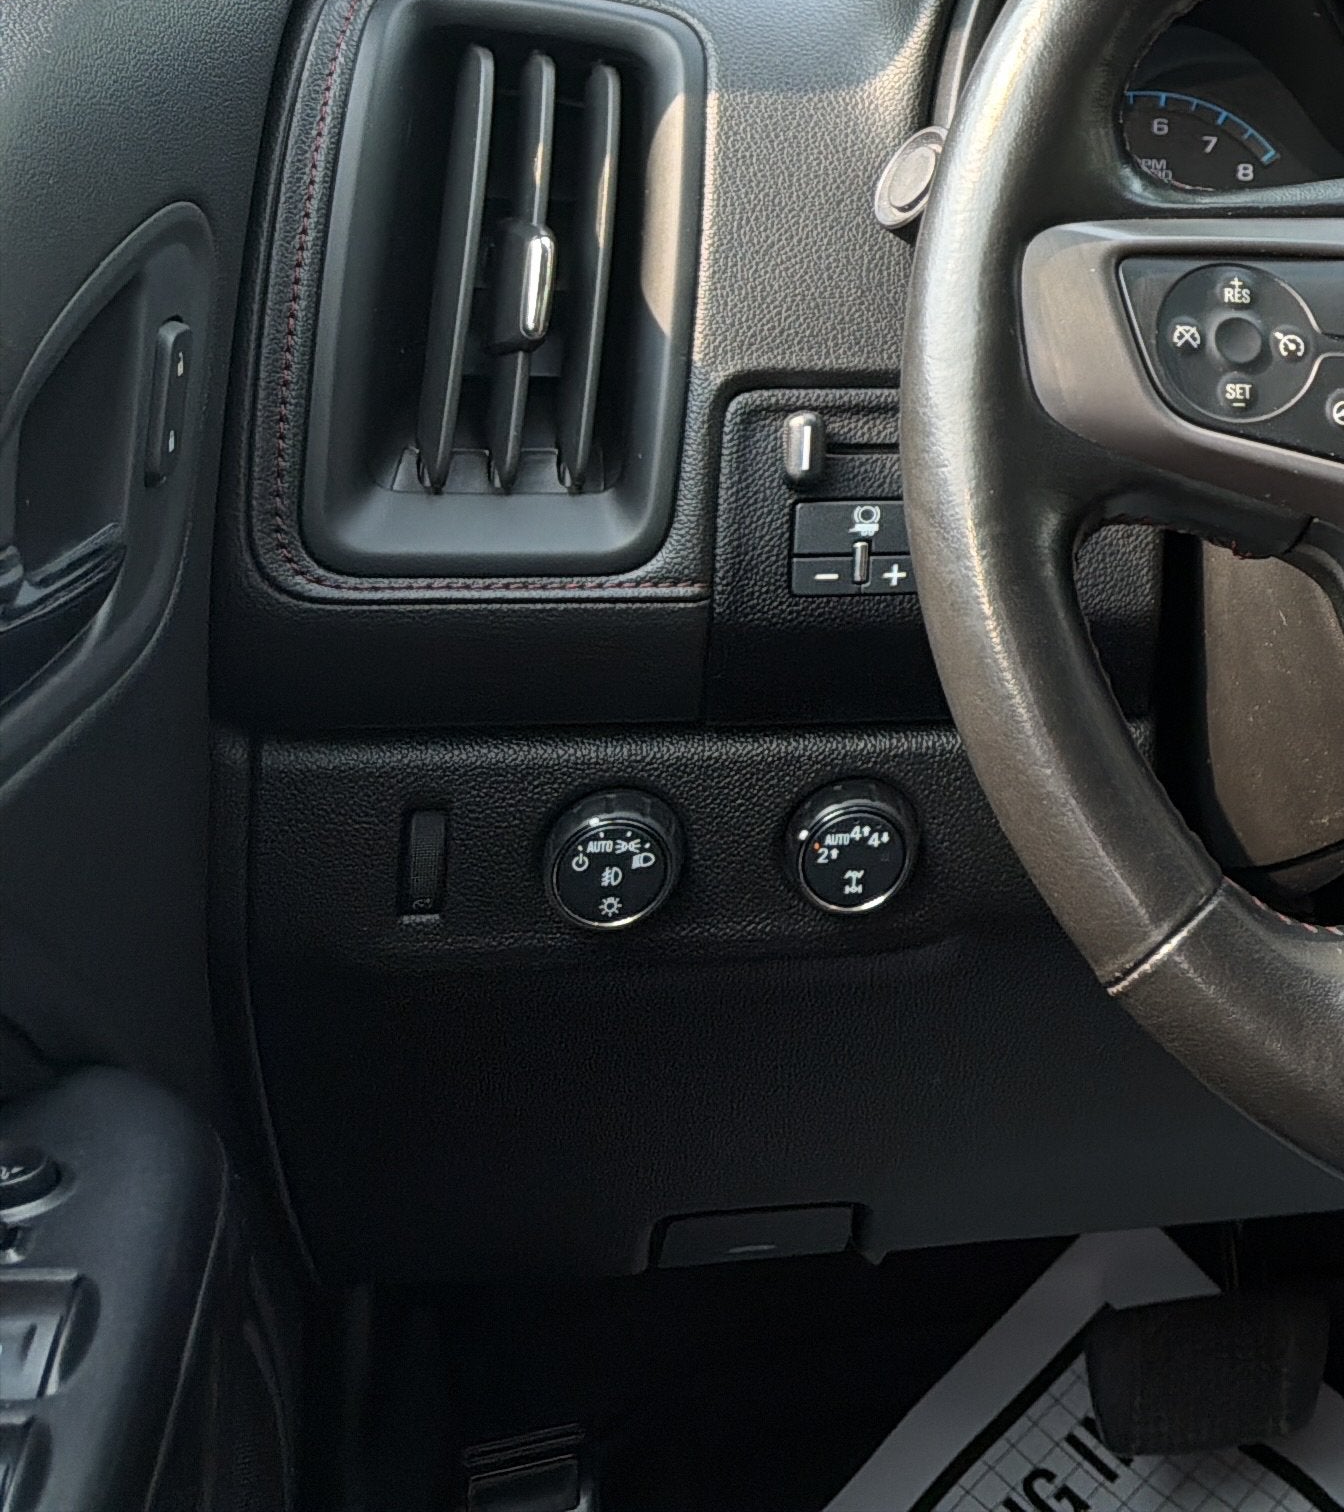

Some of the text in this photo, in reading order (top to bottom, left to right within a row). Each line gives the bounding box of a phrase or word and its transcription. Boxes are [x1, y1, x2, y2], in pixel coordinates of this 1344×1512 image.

[1153, 118, 1169, 135] 6
[1202, 136, 1218, 153] 7
[1237, 163, 1254, 182] 8
[1224, 288, 1251, 304] RES
[1225, 384, 1252, 400] SET
[824, 833, 850, 846] AUTO
[850, 825, 862, 841] 4
[867, 831, 880, 848] 4
[586, 839, 613, 854] AUTO
[816, 847, 829, 864] 2
